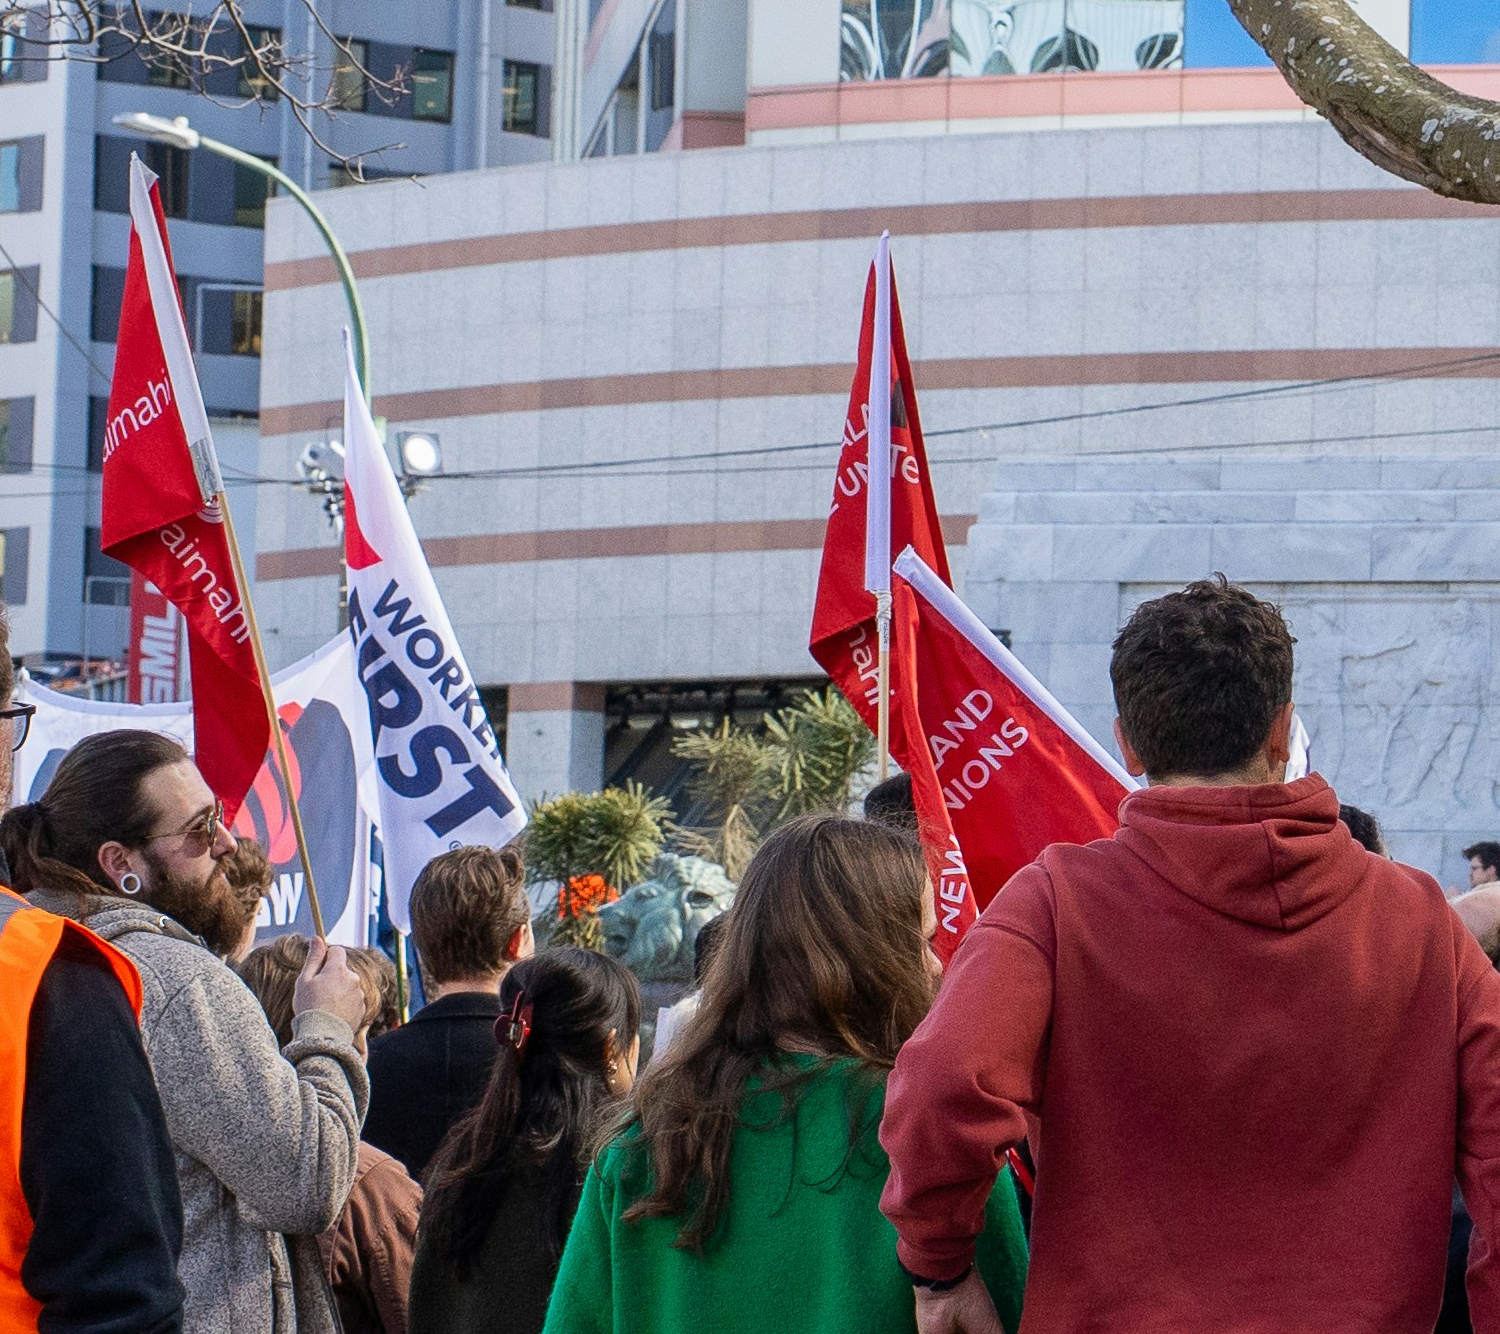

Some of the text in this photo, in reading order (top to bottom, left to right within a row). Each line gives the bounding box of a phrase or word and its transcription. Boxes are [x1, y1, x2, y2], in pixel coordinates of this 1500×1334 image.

[159, 523, 251, 645] aimahi
[372, 578, 503, 761] WORKE
[934, 688, 994, 771] AND
